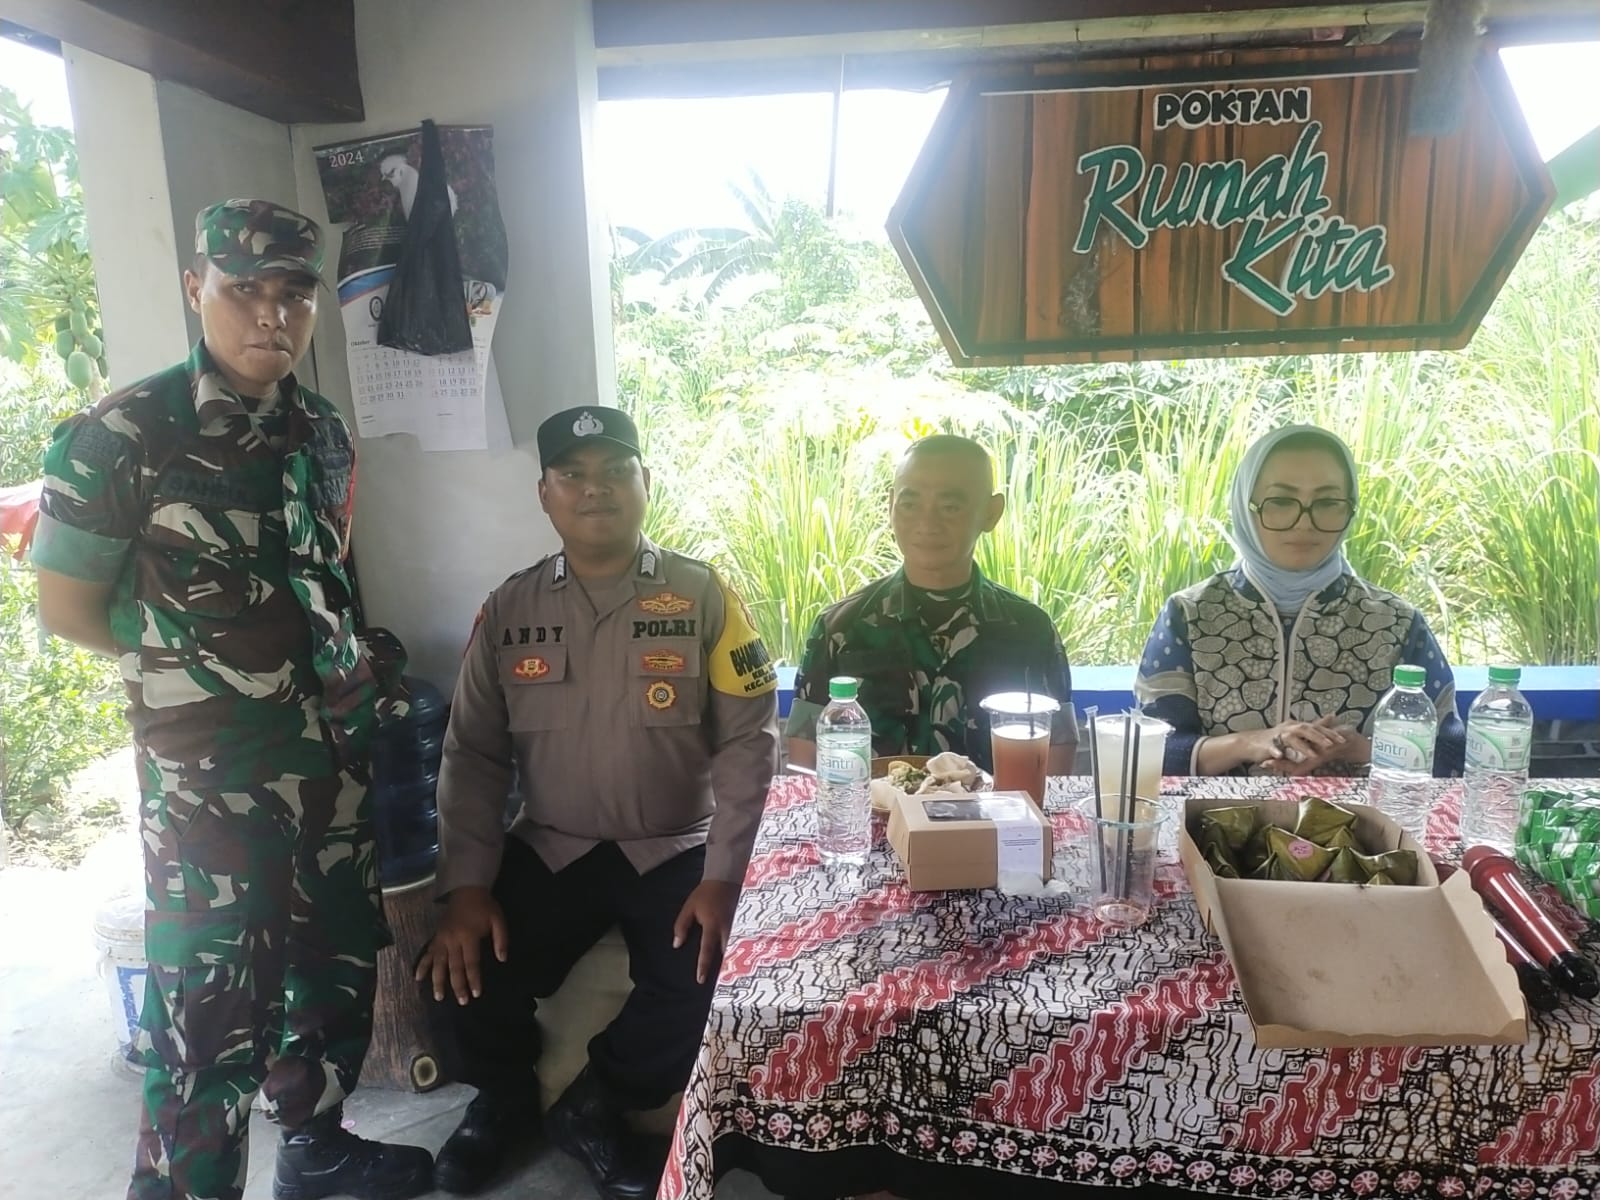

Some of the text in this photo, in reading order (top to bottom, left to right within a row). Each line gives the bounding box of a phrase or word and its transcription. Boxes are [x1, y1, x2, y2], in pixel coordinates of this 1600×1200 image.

[1154, 87, 1311, 129] POKTAN
[329, 150, 365, 168] 2024
[1073, 121, 1331, 254] Rumah
[1221, 215, 1394, 316] Kita
[502, 626, 564, 646] ANDY
[632, 619, 697, 639] POLRI
[744, 679, 764, 693] KEC.
[820, 754, 854, 770] Santri
